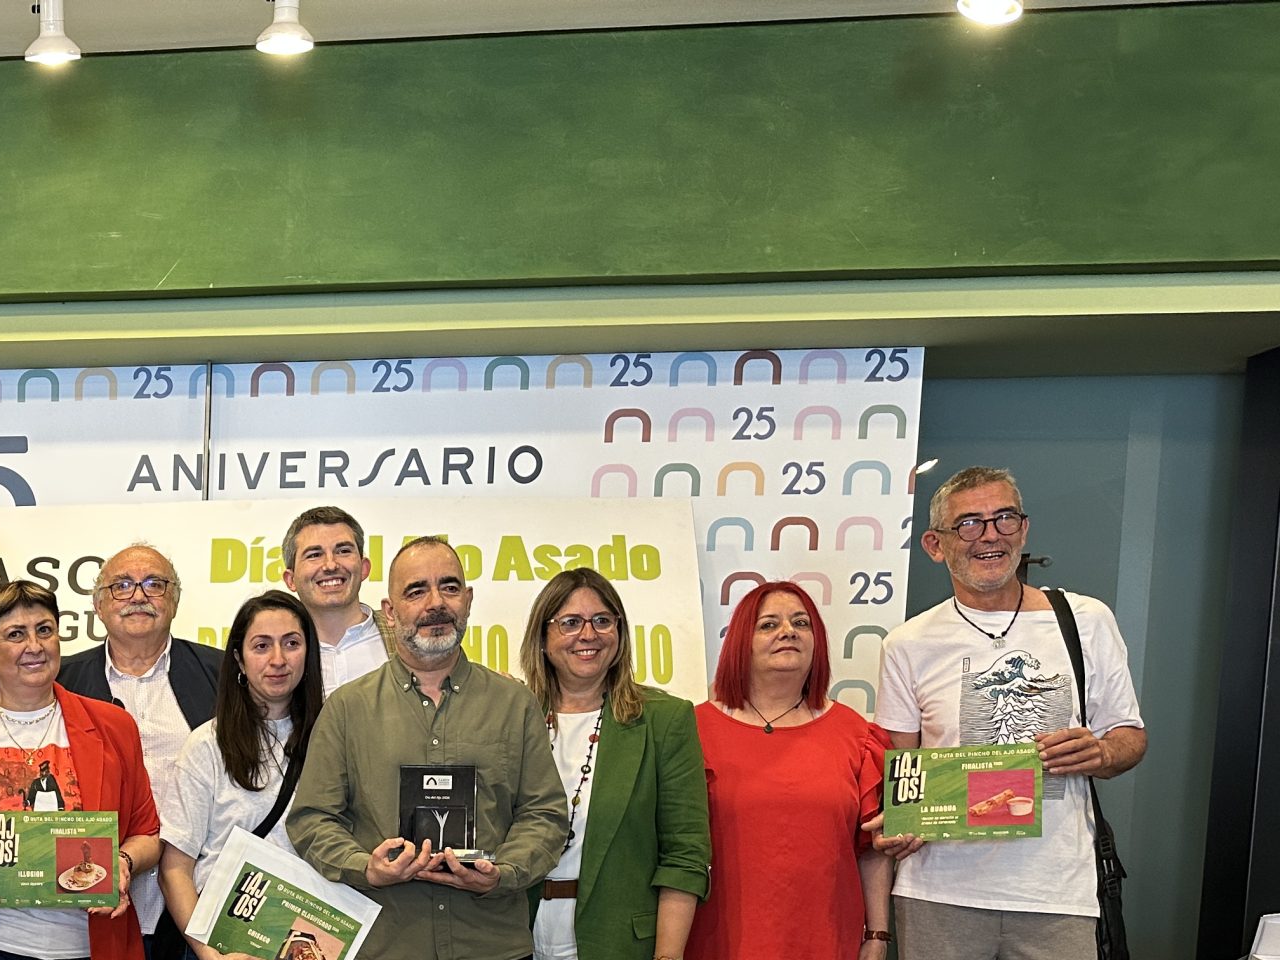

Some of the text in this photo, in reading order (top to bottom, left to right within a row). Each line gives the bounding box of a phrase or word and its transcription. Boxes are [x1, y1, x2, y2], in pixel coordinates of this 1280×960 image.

[372, 360, 414, 393] 25
[610, 353, 653, 387] 25
[865, 348, 910, 382] 25
[132, 367, 172, 399] 25
[732, 407, 776, 440] 25
[127, 445, 543, 492] ANIVERSARIO
[782, 462, 825, 495] 25
[492, 535, 661, 581] Asado
[849, 572, 893, 604] 25
[894, 752, 922, 778] ¡AJ
[897, 771, 927, 802] OS!
[241, 871, 271, 898] ¡AJ
[233, 894, 268, 922] OS!
